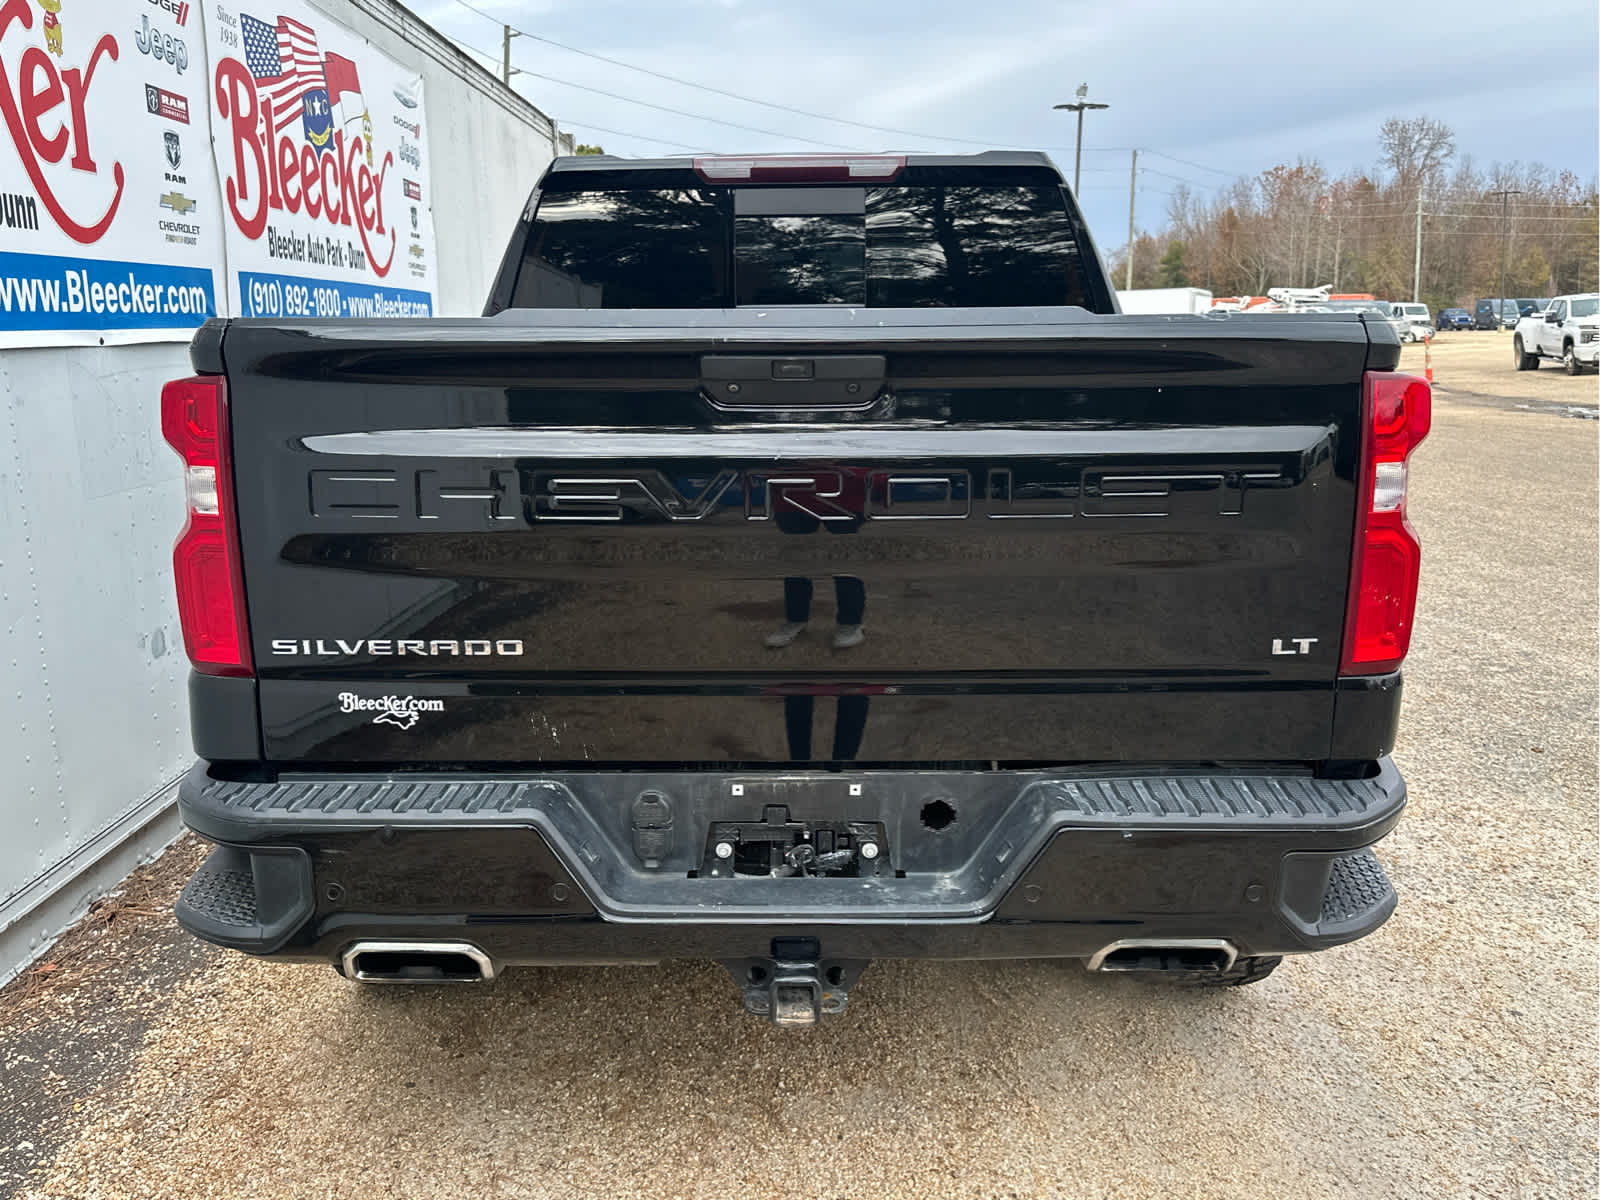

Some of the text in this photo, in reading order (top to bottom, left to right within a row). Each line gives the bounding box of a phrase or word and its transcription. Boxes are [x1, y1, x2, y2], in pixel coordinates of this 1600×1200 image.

[217, 4, 237, 28] Since
[134, 14, 188, 75] Jeep
[220, 27, 238, 48] 1938
[161, 94, 187, 111] RAM
[164, 172, 187, 185] RAM
[0, 192, 39, 231] unn
[159, 220, 200, 235] CHEVROLET
[267, 226, 306, 262] Bleecker
[307, 232, 326, 265] Auto
[326, 236, 344, 268] Park
[347, 241, 366, 271] Dunn
[248, 277, 283, 317] (910)
[285, 284, 341, 317] 892-1800
[347, 292, 430, 318] www.Bleecker.com
[308, 465, 1283, 520] CHEVROLET
[271, 639, 525, 656] SILVERADO
[1271, 638, 1319, 655] LT
